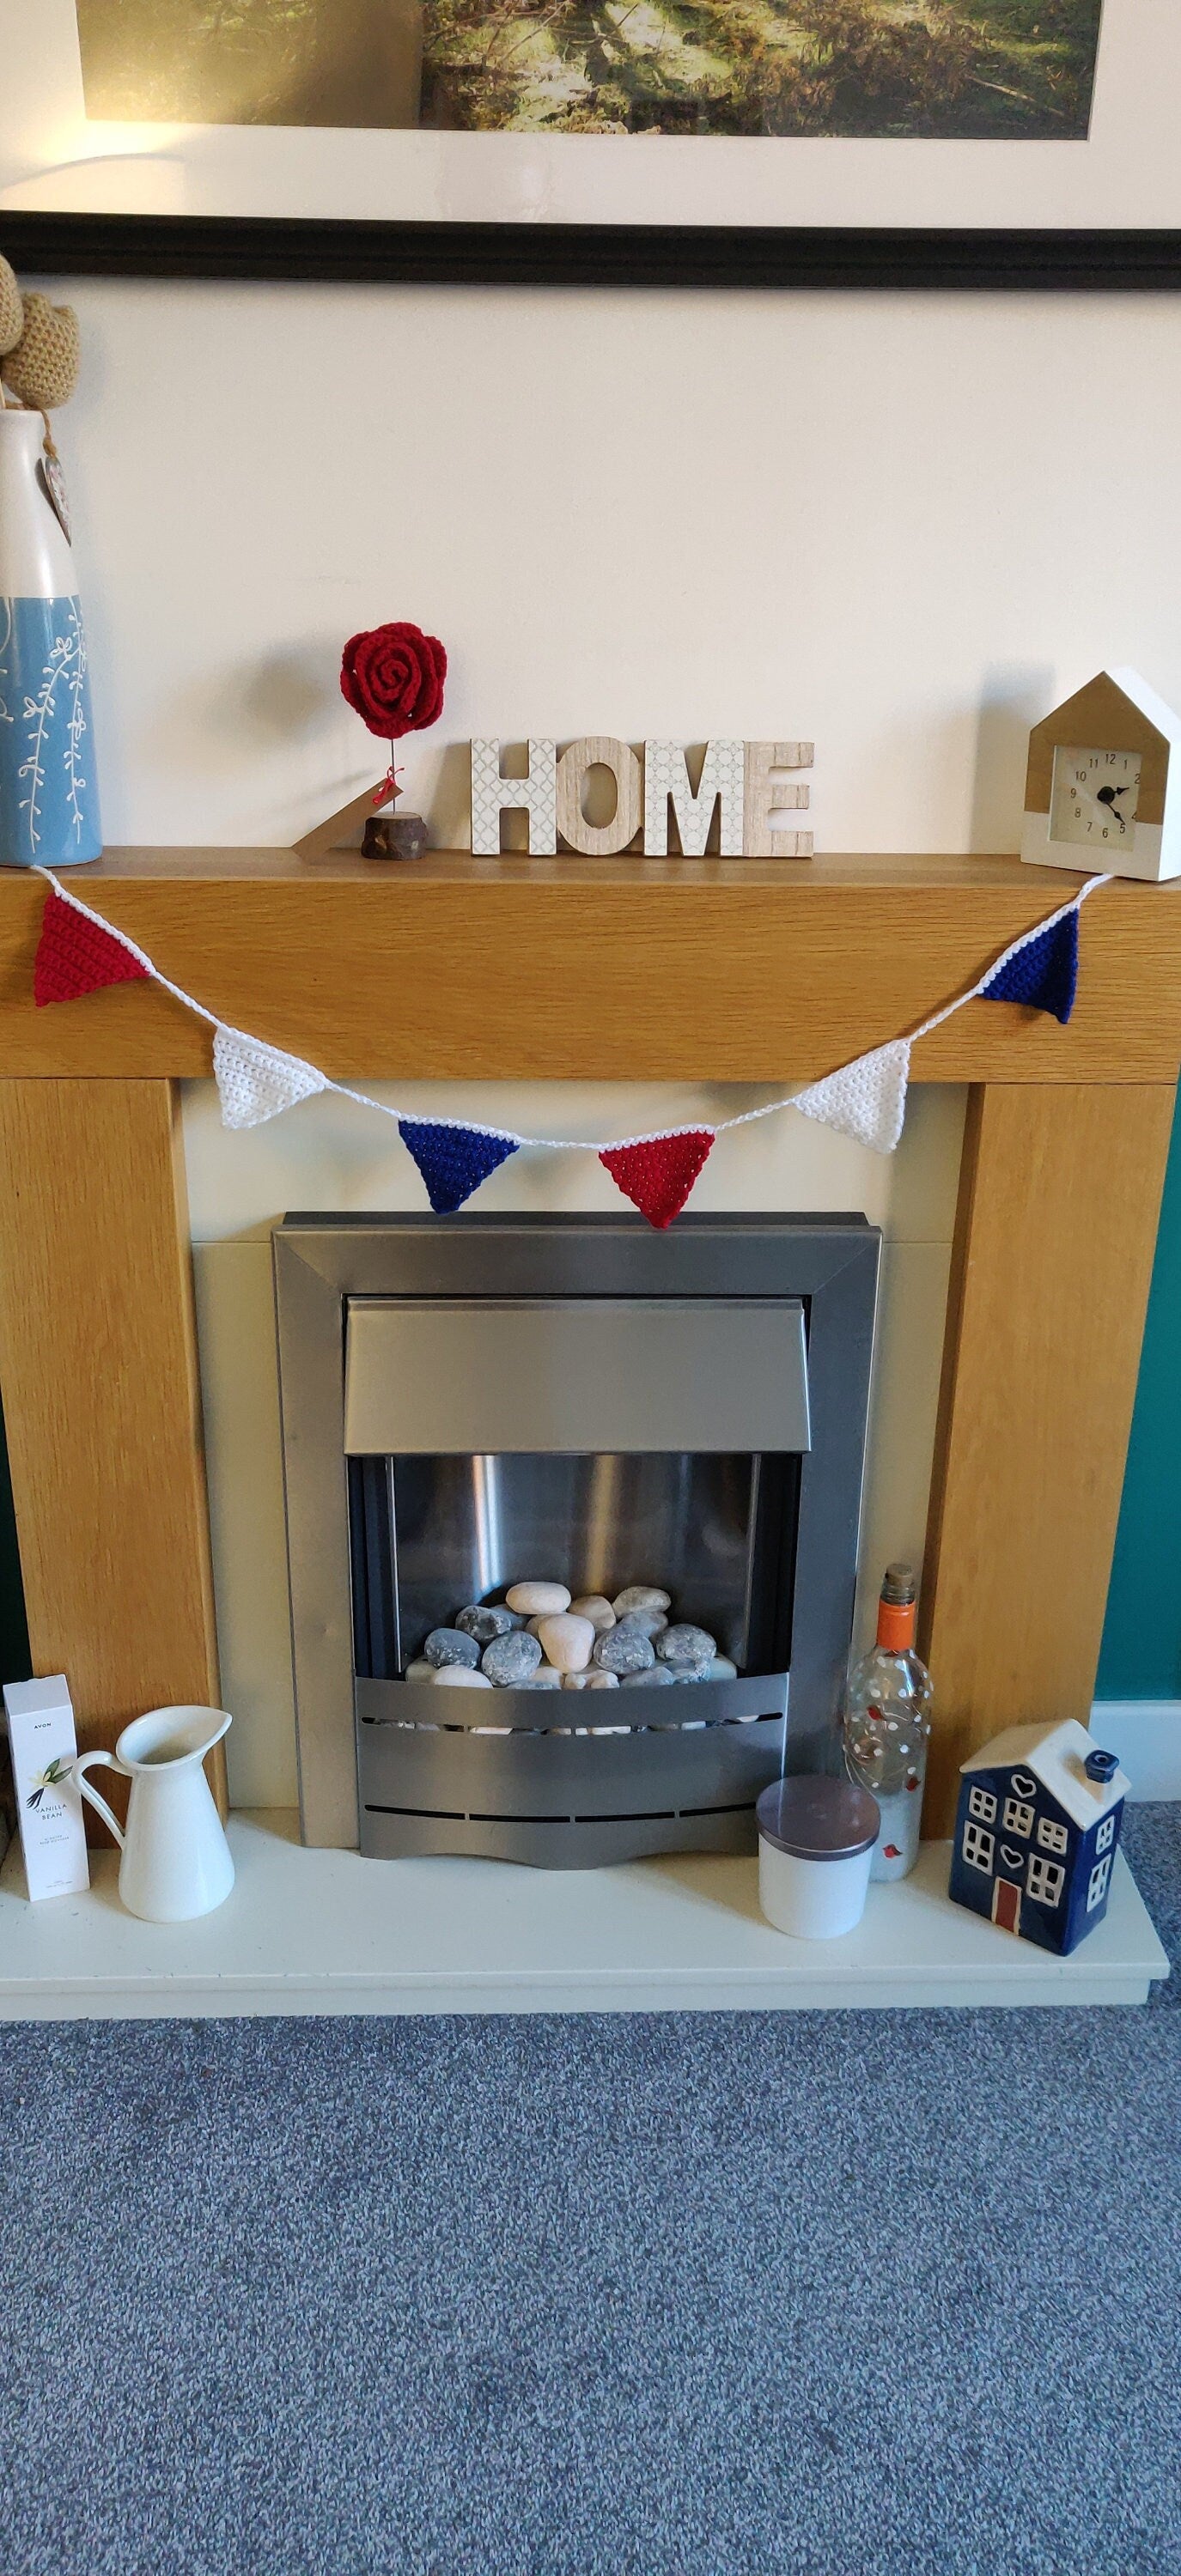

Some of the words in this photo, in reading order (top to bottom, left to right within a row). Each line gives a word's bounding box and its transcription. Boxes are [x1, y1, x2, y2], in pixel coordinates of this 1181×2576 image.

[1089, 758, 1099, 769] 11
[1105, 754, 1116, 765] 12
[1123, 759, 1128, 769] 1
[1075, 771, 1087, 781] 10
[1134, 773, 1141, 784] 2
[470, 736, 815, 857] HOME
[1070, 788, 1077, 799] 9
[1074, 807, 1081, 818] 8
[1087, 821, 1093, 832] 7
[1119, 823, 1126, 834] 5
[1102, 828, 1109, 838] 6
[35, 1803, 68, 1814] VANILLA
[41, 1812, 63, 1820] BEAN
